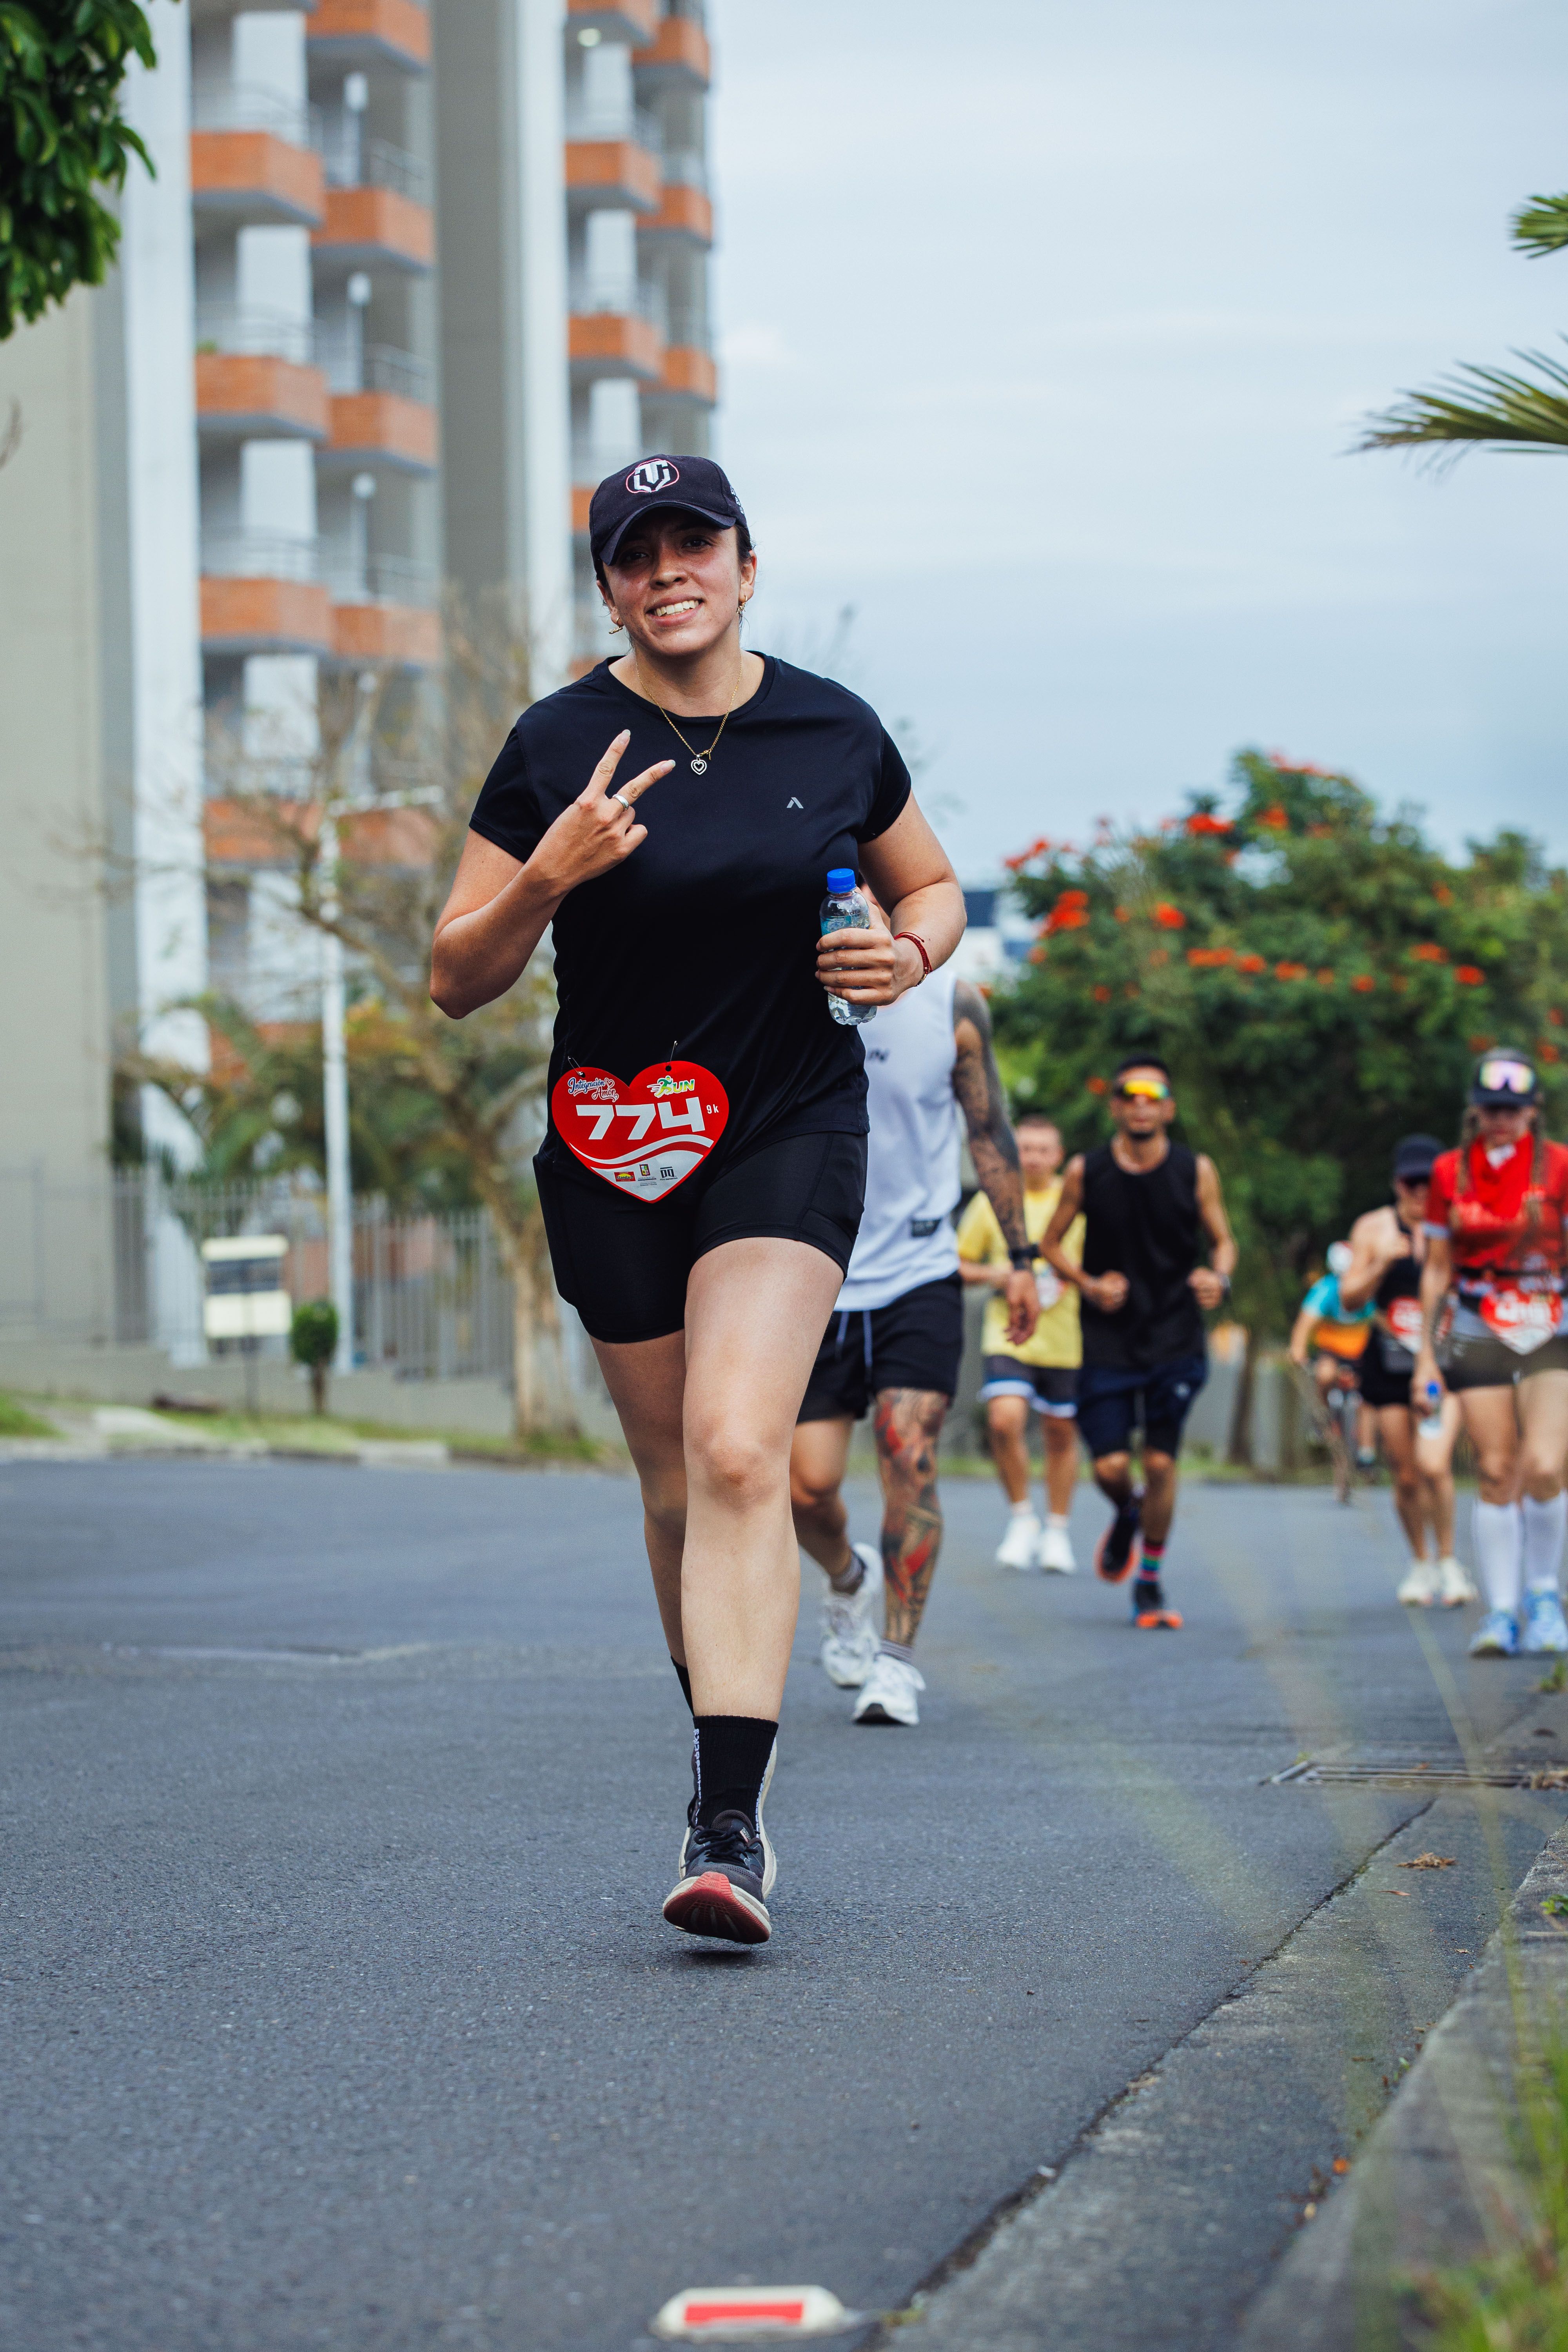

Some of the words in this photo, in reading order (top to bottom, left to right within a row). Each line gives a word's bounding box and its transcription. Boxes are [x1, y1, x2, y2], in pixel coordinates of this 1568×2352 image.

[568, 1077, 605, 1094] Integración
[592, 1085, 616, 1101] Amor
[576, 1096, 705, 1140] 774
[706, 1104, 719, 1114] 9k
